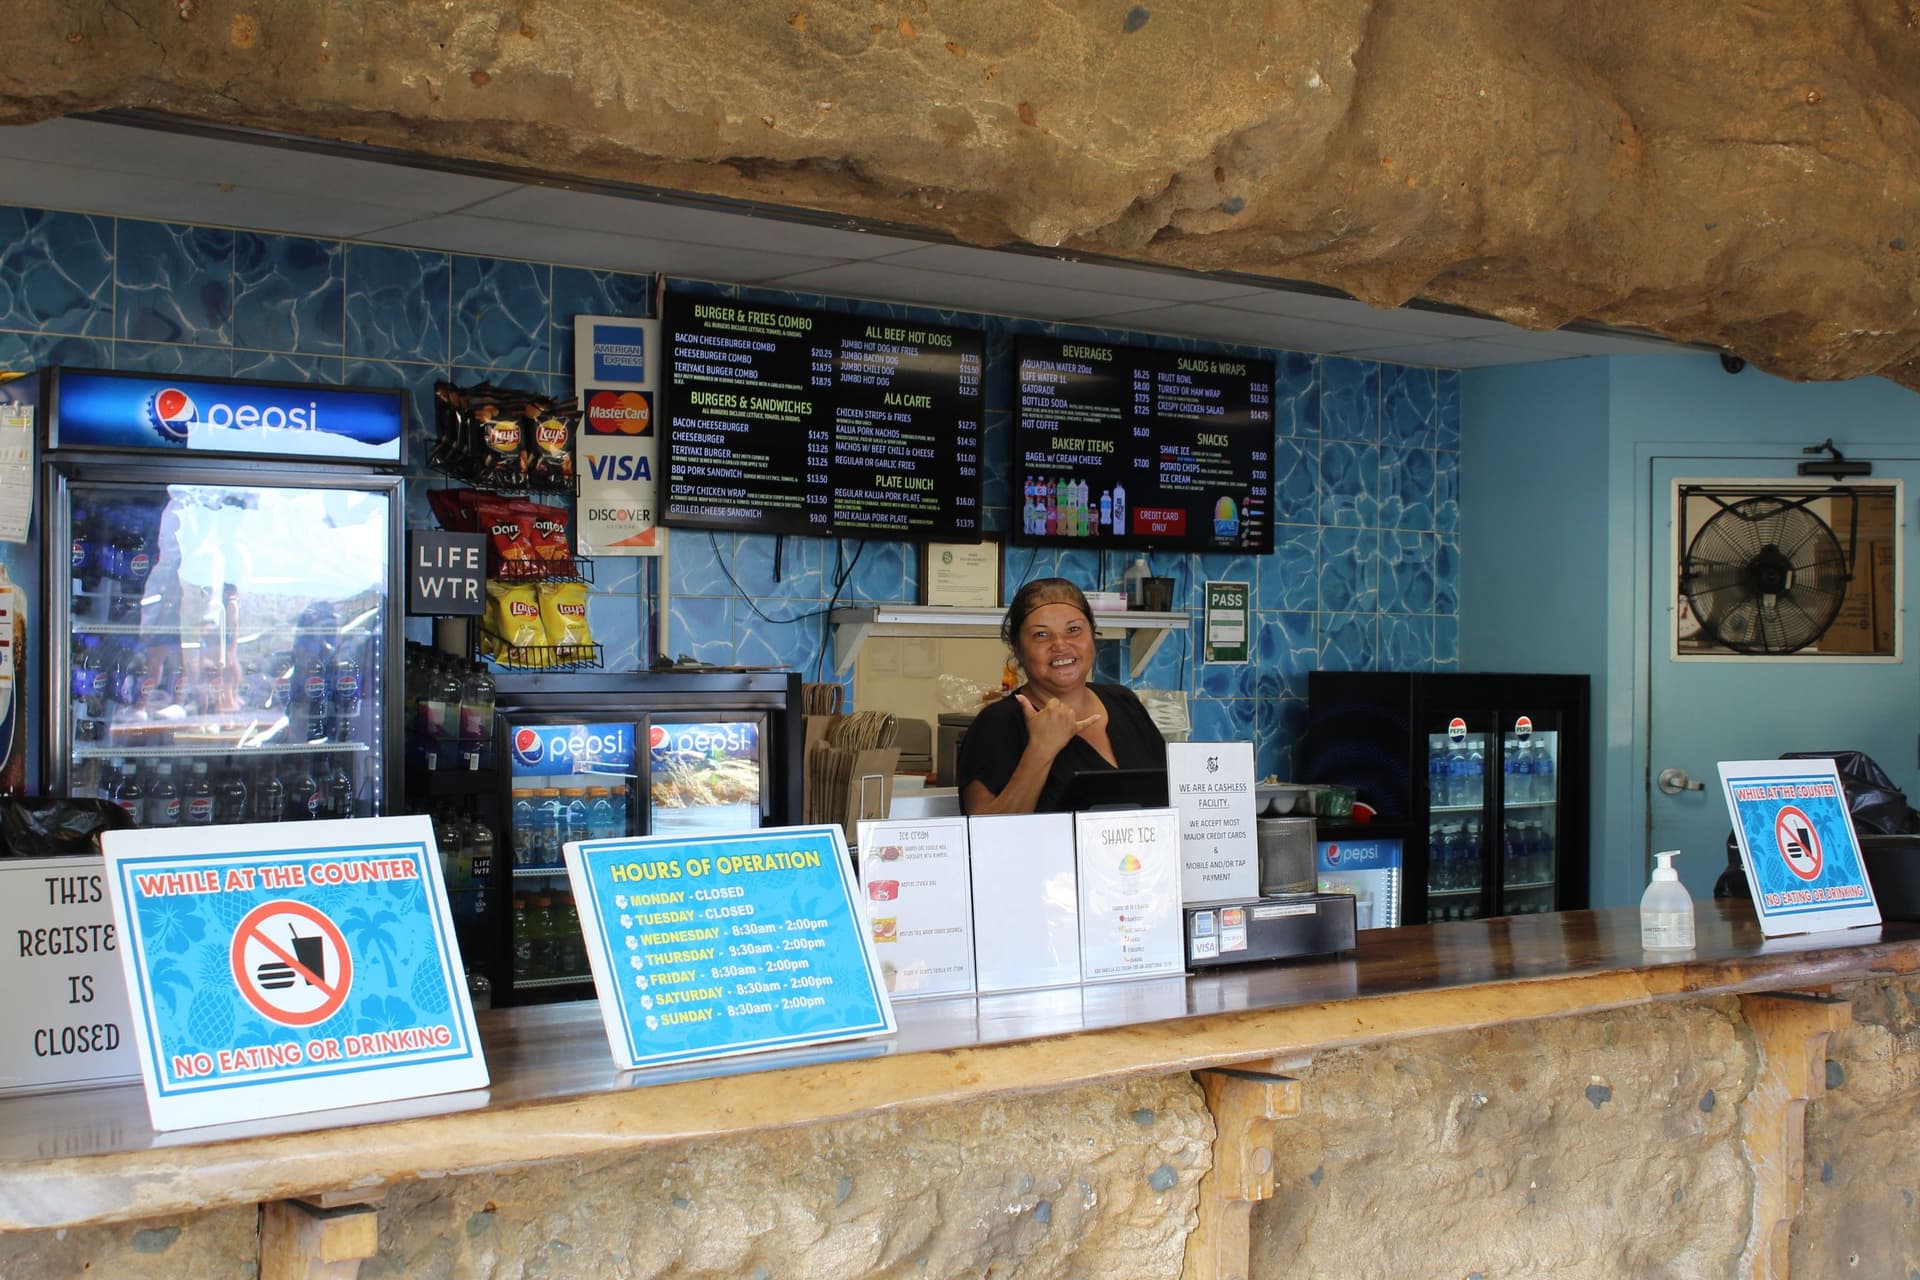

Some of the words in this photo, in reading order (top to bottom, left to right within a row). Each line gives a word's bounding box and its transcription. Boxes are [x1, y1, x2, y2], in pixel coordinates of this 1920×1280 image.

[695, 305, 734, 321] BURGER
[737, 311, 745, 322] &
[748, 312, 776, 325] FRIES
[778, 314, 812, 330] COMBO
[866, 325, 882, 339] ALL
[885, 328, 906, 342] BEEF
[909, 332, 926, 344] HOT
[928, 333, 952, 347] DOGS
[594, 346, 640, 354] AMERICAN
[675, 333, 698, 344] BACON
[700, 335, 751, 349] CHEESEBURGER
[752, 341, 776, 352] COMBO
[811, 348, 832, 358] $20.25
[1063, 344, 1112, 361] BEVERAGES
[604, 357, 642, 366] EXPRESS
[674, 348, 727, 361] CHEESEBURGER
[728, 353, 752, 364] COMBO
[674, 362, 705, 373] TERIYAKI
[706, 365, 733, 377] BURGER
[735, 369, 758, 379] COMBO
[1178, 357, 1208, 373] SALADS
[1211, 362, 1217, 373] &
[1219, 363, 1246, 376] WRAPS
[691, 391, 737, 408] BURGERS
[739, 396, 747, 408] &
[750, 397, 812, 415] SANDWICHES
[884, 392, 902, 405] ALA
[904, 394, 931, 408] CARTE
[208, 401, 316, 440] pepsi
[590, 406, 648, 420] MasterCard
[836, 407, 863, 419] CHICKEN
[865, 410, 886, 420] STRIPS
[888, 413, 892, 421] &
[894, 413, 912, 423] FRIES
[673, 417, 695, 428] BACON
[697, 420, 749, 433] CHEESEBURGER
[1022, 419, 1034, 429] HOT
[1036, 421, 1059, 431] COFFEE
[672, 431, 725, 444] CHEESEBURGER
[1052, 437, 1086, 452] BAKERY
[1087, 439, 1114, 454] ITEMS
[1198, 433, 1229, 447] SNACKS
[672, 445, 702, 456] TERIYAKI
[704, 447, 731, 458] BURGER
[1025, 451, 1045, 462] BAGEL
[1055, 454, 1077, 465] CREAM
[1079, 455, 1102, 466] CHEESE
[584, 455, 652, 481] VISA
[835, 455, 864, 466] REGULAR
[865, 458, 874, 467] OR
[875, 458, 897, 469] GARLIC
[898, 460, 916, 470] FRIES
[1160, 462, 1181, 471] POTATO
[1182, 463, 1200, 473] CHIPS
[672, 465, 686, 475] BBQ
[687, 466, 706, 476] PORK
[707, 467, 742, 478] SANDWICH
[807, 474, 828, 484] $13.50
[876, 474, 902, 488] PLATE
[904, 477, 934, 491] LUNCH
[671, 485, 695, 494] CRISPY
[697, 486, 726, 496] CHICKEN
[728, 488, 746, 497] WRAP
[589, 508, 650, 521] DISCOVER
[671, 504, 699, 514] GRILLED
[700, 506, 726, 516] CHEESE
[728, 508, 762, 519] SANDWICH
[810, 514, 827, 523] $9.00
[1140, 510, 1161, 521] CREDIT
[1163, 511, 1179, 521] CARD
[1152, 522, 1167, 532] ONLY
[419, 546, 479, 569] LIFE
[419, 577, 478, 601] WTR
[1212, 594, 1243, 607] PASS
[550, 730, 623, 762] pepsi
[678, 728, 746, 758] pepsi
[1179, 784, 1191, 792] WE
[1193, 784, 1206, 792] ARE
[1215, 783, 1247, 792] CASHLESS
[1736, 787, 1766, 800] WHILE
[1767, 787, 1777, 799] AT
[1779, 786, 1795, 798] THE
[1797, 784, 1835, 797] COUNTER
[1189, 819, 1199, 828] WE
[1201, 819, 1222, 827] ACCEPT
[1224, 818, 1240, 826] MOST
[1101, 828, 1134, 845] SHAVE
[1138, 827, 1156, 843] ICE
[1184, 832, 1205, 841] MAJOR
[1206, 832, 1226, 840] CREDIT
[1228, 831, 1246, 839] CARDS
[1344, 844, 1378, 862] pepsi
[610, 861, 682, 883] HOURS
[686, 857, 711, 877] OF
[716, 850, 822, 875] OPERATION
[1186, 862, 1208, 870] MOBILE
[1210, 860, 1234, 869] AND/OR
[1235, 859, 1246, 867] TAP
[138, 870, 220, 897] WHILE
[226, 869, 253, 889] AT
[259, 866, 305, 888] THE
[310, 859, 418, 884] COUNTER
[1203, 873, 1231, 882] PAYMENT
[45, 875, 103, 905] THIS
[1766, 894, 1780, 906] NO
[1782, 891, 1811, 904] EATING
[1813, 890, 1824, 901] OR
[1825, 886, 1863, 900] DRINKING
[630, 891, 684, 907] MONDAY
[636, 910, 694, 926] TUESDAY
[18, 924, 116, 957] REGISTE
[640, 928, 719, 945] WEDNESDAY
[732, 923, 776, 936] 8:30am
[785, 919, 828, 931] 2:00pm
[646, 948, 715, 966] THURSDAY
[782, 939, 825, 951] 2:00pm
[1197, 943, 1215, 953] VISA
[651, 970, 696, 985] FRIDAY
[711, 966, 756, 978] 8:30am
[766, 959, 809, 972] 2:00pm
[68, 975, 94, 1004] IS
[656, 987, 723, 1005] SATURDAY
[736, 982, 780, 995] 8:30am
[790, 976, 833, 989] 2:00pm
[661, 1009, 712, 1025] SUNDAY
[727, 1002, 772, 1016] 8:30am
[782, 997, 825, 1010] 2:00pm
[34, 1023, 120, 1057] CLOSED
[174, 1054, 212, 1078] NO
[219, 1043, 301, 1072] EATING
[307, 1038, 340, 1060] OR
[347, 1026, 452, 1056] DRINKING
